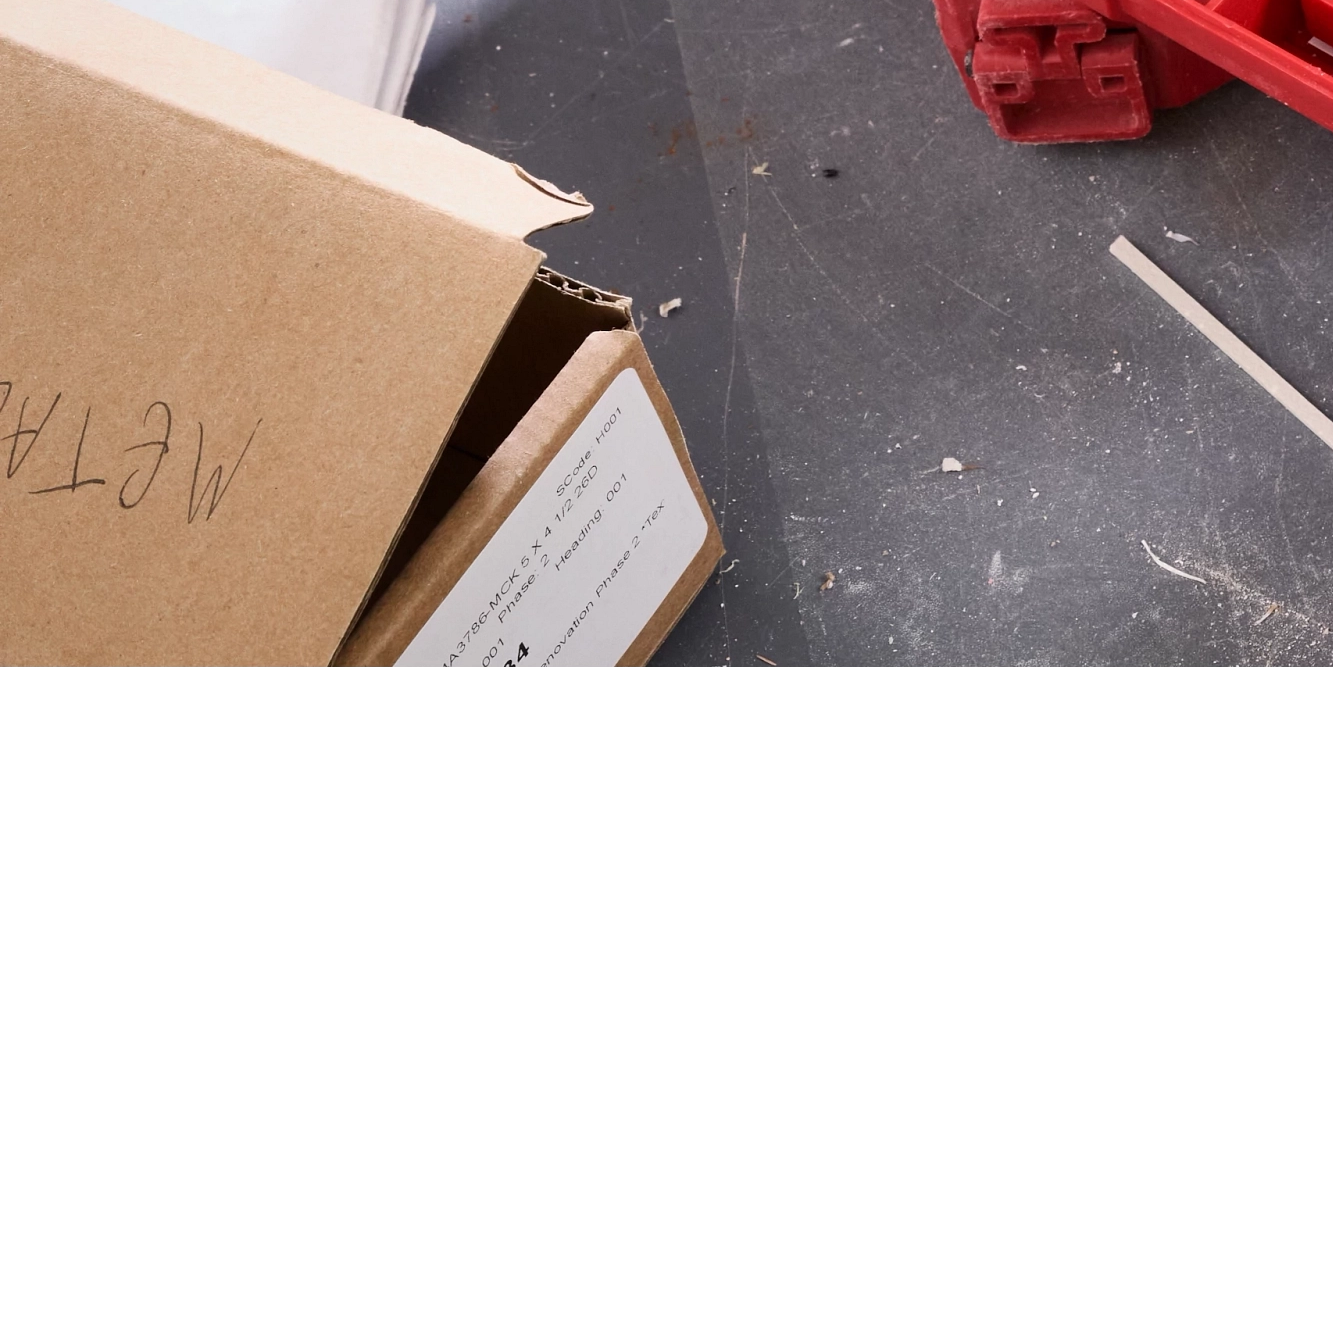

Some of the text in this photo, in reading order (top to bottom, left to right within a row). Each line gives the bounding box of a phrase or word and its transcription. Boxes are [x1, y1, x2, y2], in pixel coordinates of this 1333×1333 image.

[556, 406, 622, 497] SCode: H001
[520, 556, 530, 569] 5
[531, 542, 543, 555] X
[543, 526, 552, 539] 4
[553, 498, 574, 522] 1/2
[574, 464, 599, 499] 26D
[554, 507, 606, 572] Heading:
[606, 473, 628, 502] 001
[496, 553, 550, 624] Phase: 2
[595, 554, 630, 599] Phase
[631, 535, 642, 548] 2
